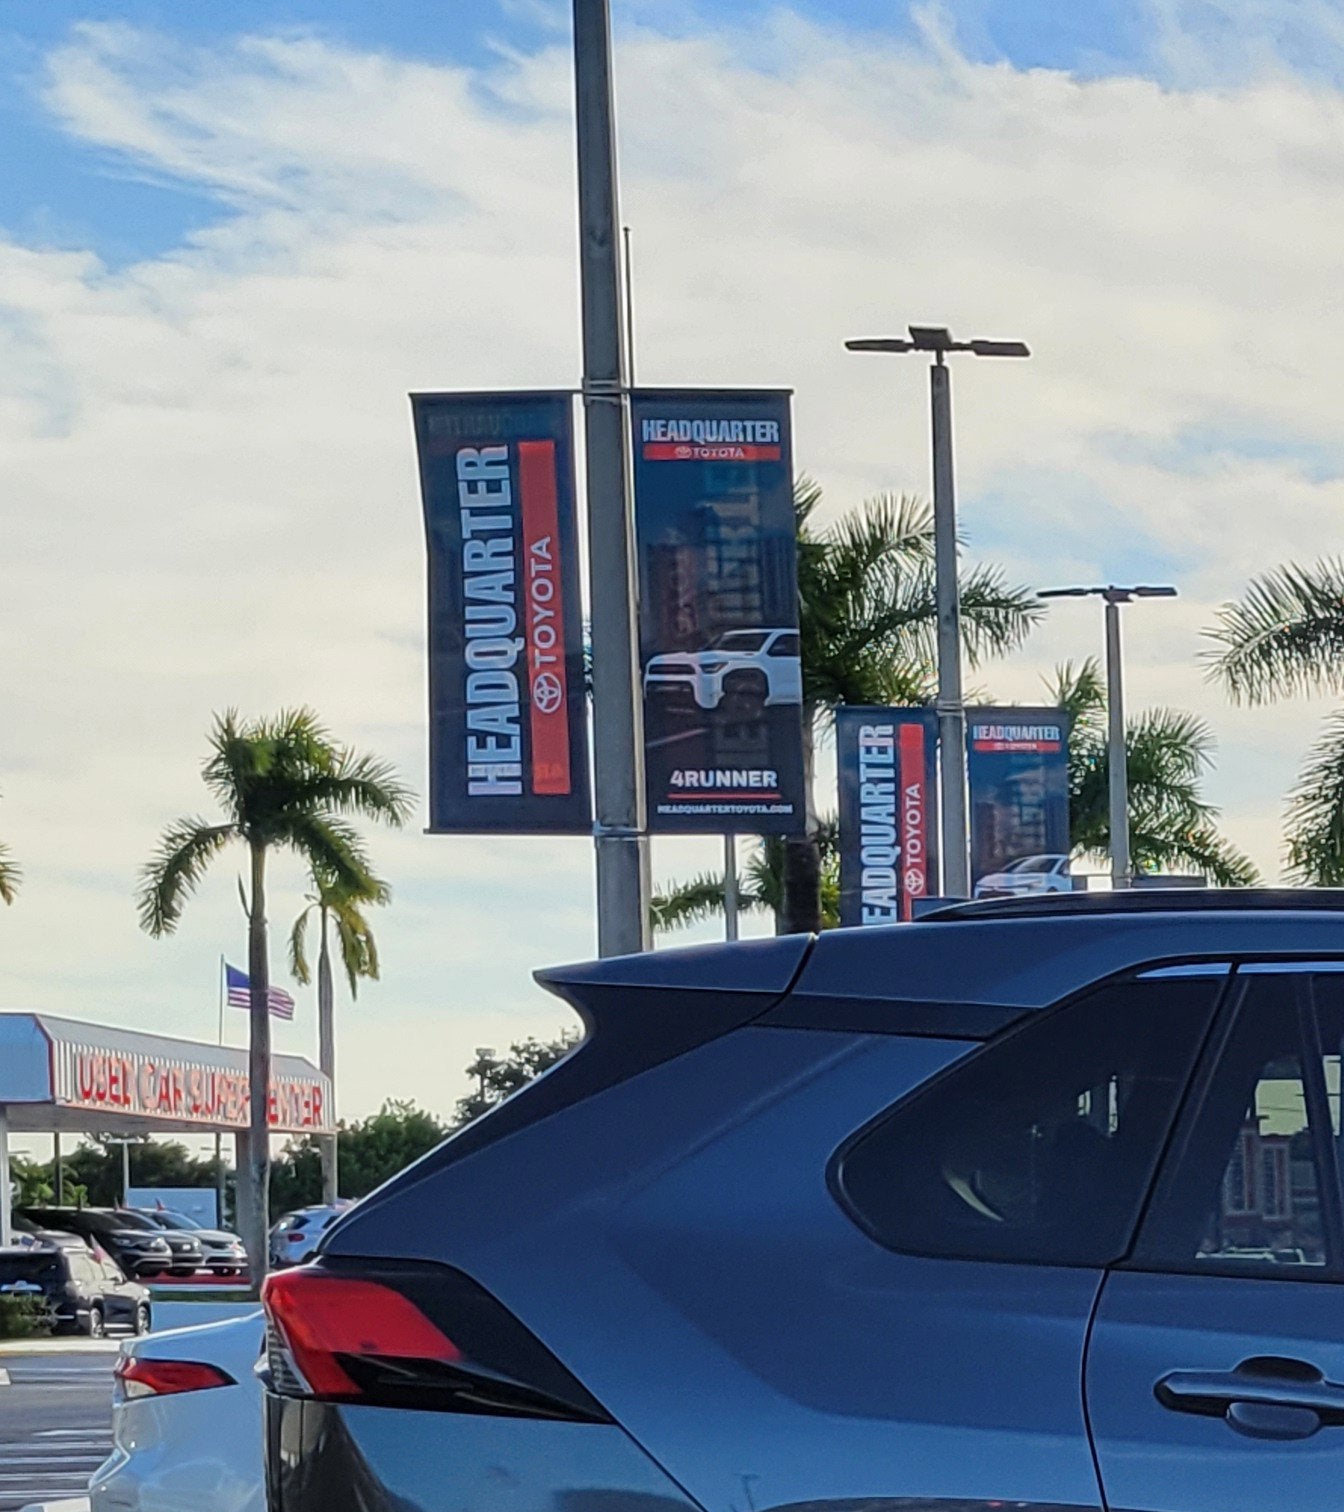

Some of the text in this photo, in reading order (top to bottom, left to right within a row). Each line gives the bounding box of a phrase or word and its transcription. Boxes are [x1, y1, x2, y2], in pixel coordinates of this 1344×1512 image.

[642, 420, 779, 445] HEADQUARTER
[456, 444, 525, 796] HEADQUARTER
[530, 536, 555, 669] TOYOTA
[973, 725, 1060, 742] HEADQUARTER
[670, 770, 778, 788] 4RUNNER
[858, 724, 902, 926] EADQUARTER
[904, 783, 922, 867] TOYOTA
[139, 1063, 184, 1113] CAR
[266, 1081, 323, 1127] ENTER
